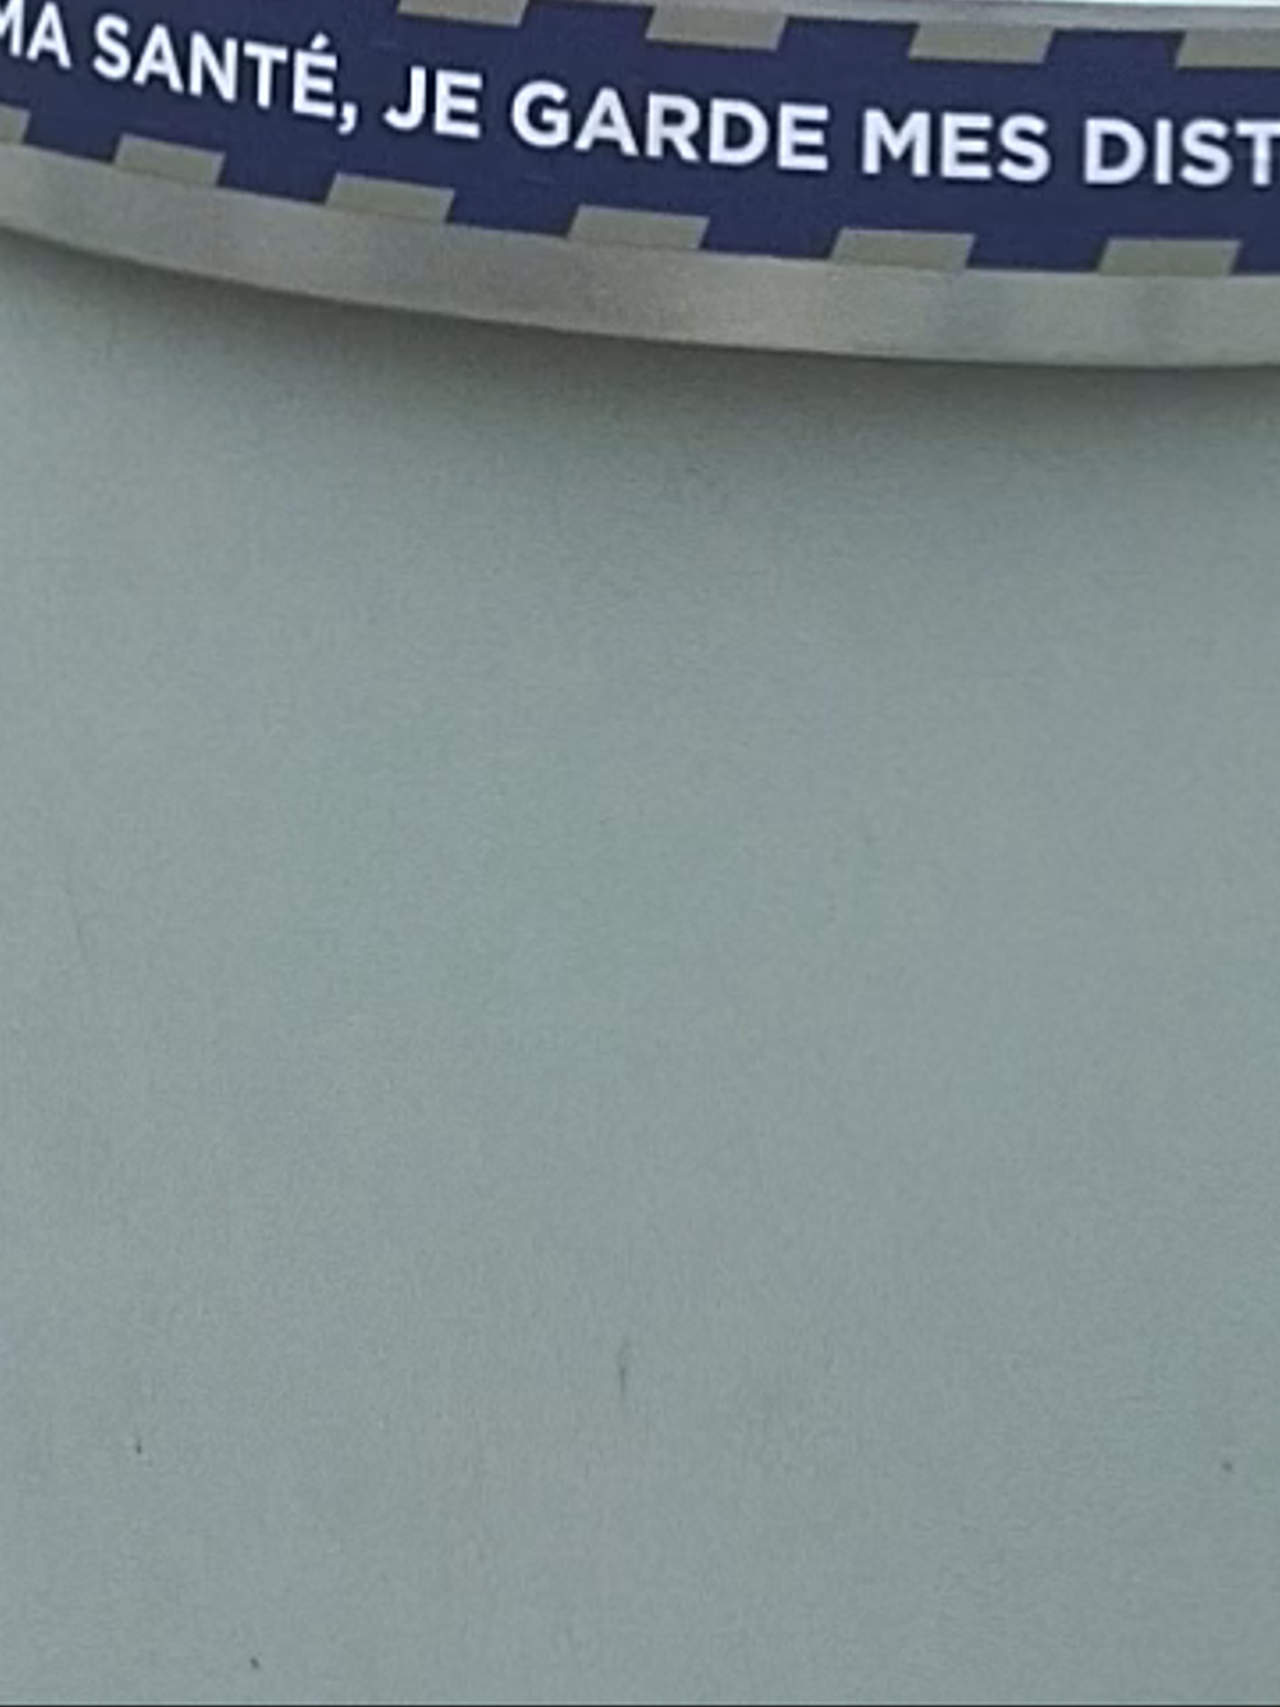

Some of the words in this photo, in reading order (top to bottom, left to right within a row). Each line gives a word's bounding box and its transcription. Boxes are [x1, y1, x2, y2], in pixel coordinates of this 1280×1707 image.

[90, 13, 359, 135] SANTÉ,
[382, 66, 486, 141] JE
[510, 80, 830, 172] GARDE
[860, 109, 1051, 182] MES
